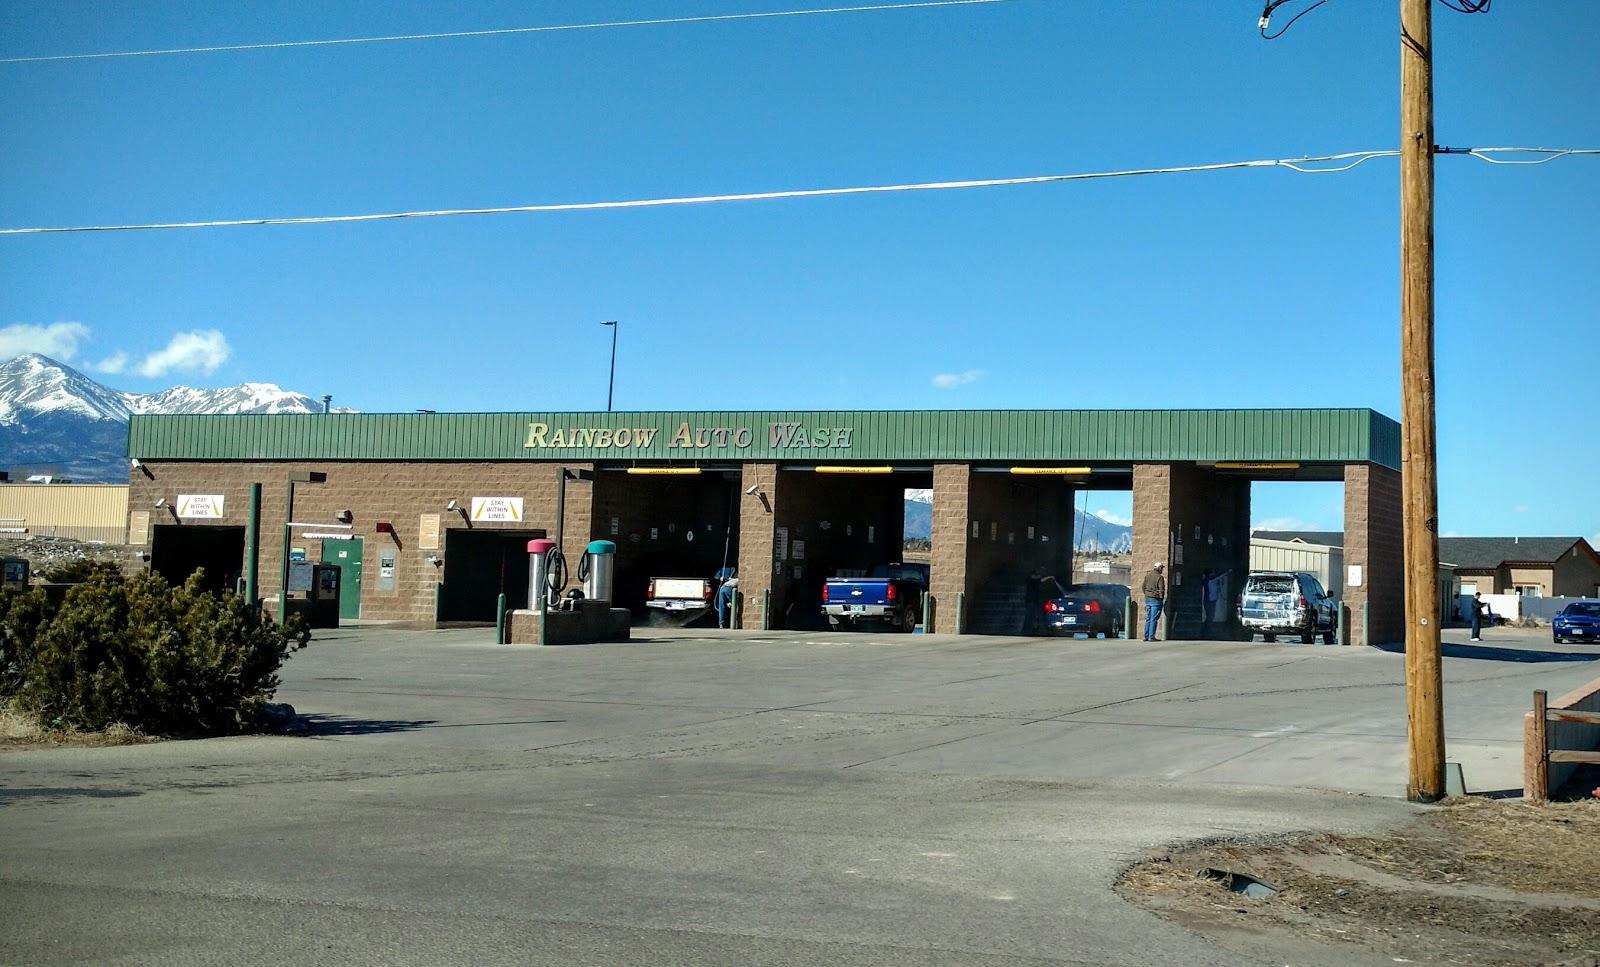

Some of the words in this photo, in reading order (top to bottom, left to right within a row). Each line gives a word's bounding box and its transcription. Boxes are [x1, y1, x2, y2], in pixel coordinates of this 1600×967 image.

[524, 422, 657, 449] RAINBOW
[669, 422, 753, 449] AUTO
[768, 421, 854, 449] WASH
